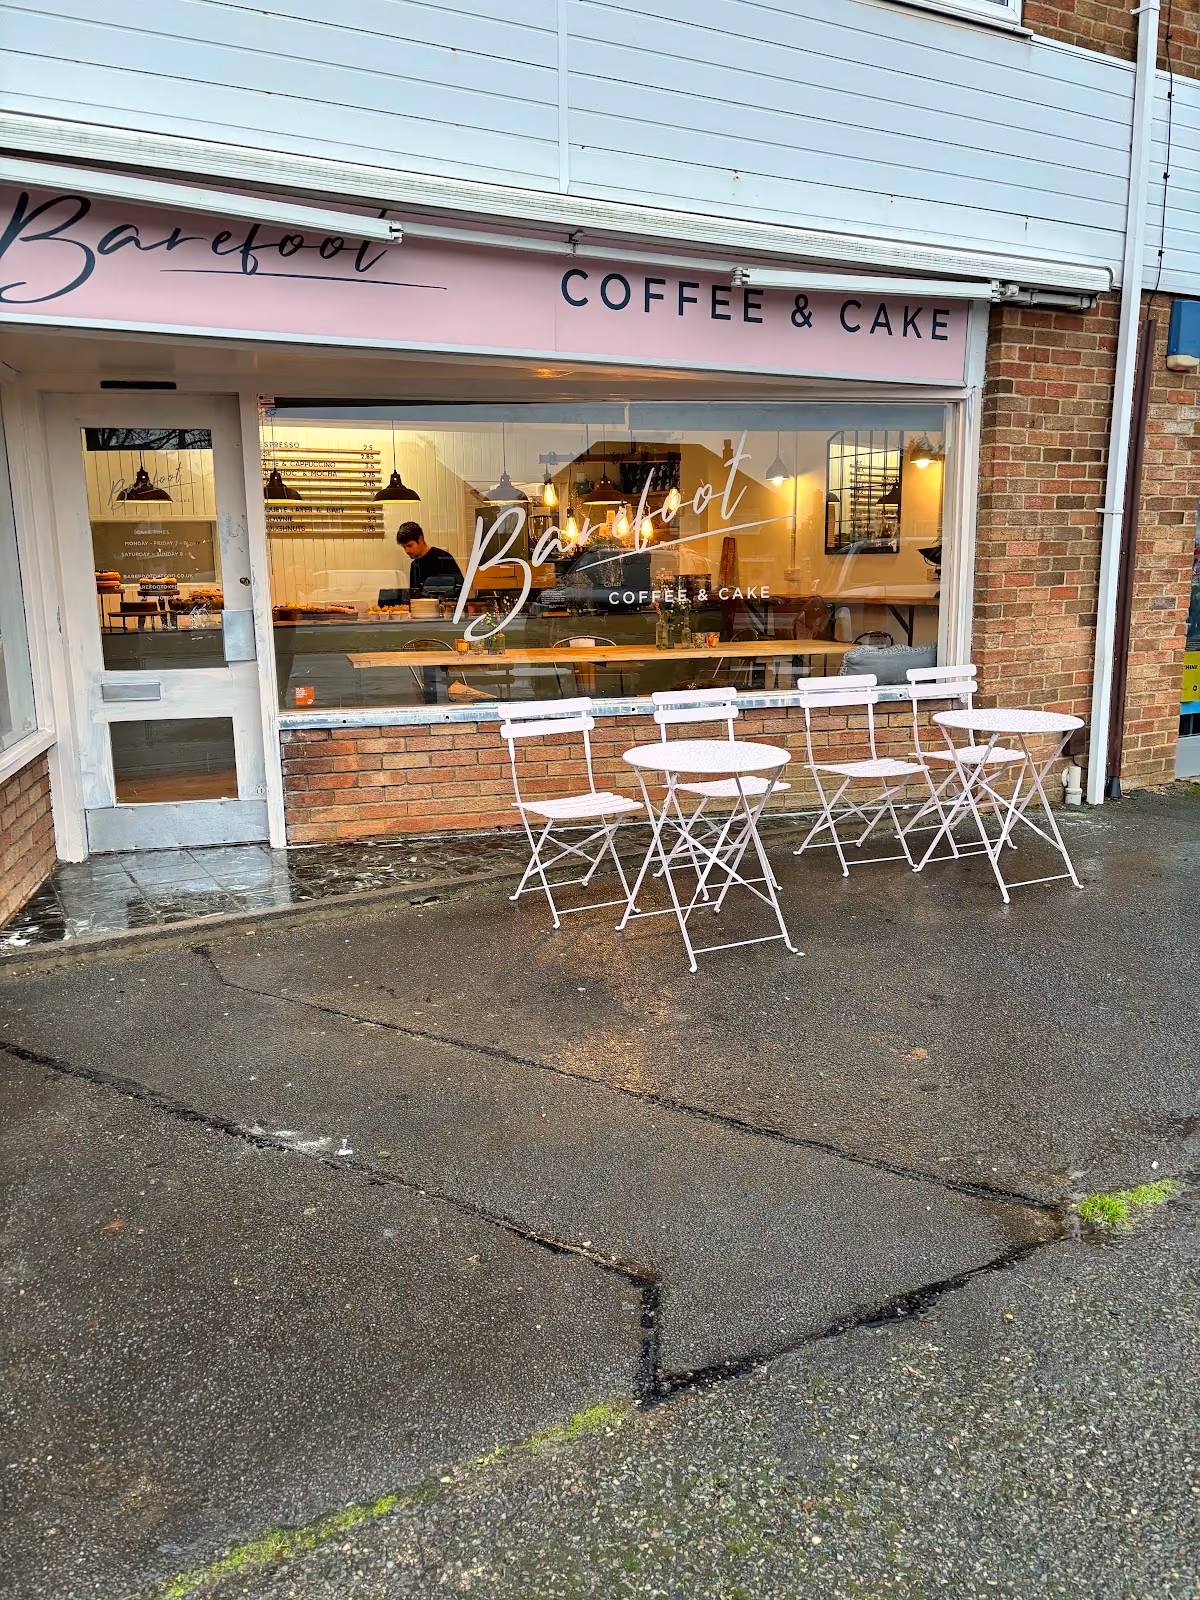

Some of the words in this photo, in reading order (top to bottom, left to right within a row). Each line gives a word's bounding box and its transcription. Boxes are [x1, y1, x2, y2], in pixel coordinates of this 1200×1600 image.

[0, 191, 390, 304] Barefoot
[561, 269, 764, 324] COFFEE
[791, 294, 813, 328] &
[839, 299, 950, 341] CAKE
[453, 430, 752, 642] Barefoot
[608, 589, 688, 605] COFFEE
[697, 588, 708, 601] &
[718, 586, 771, 601] CAKE
